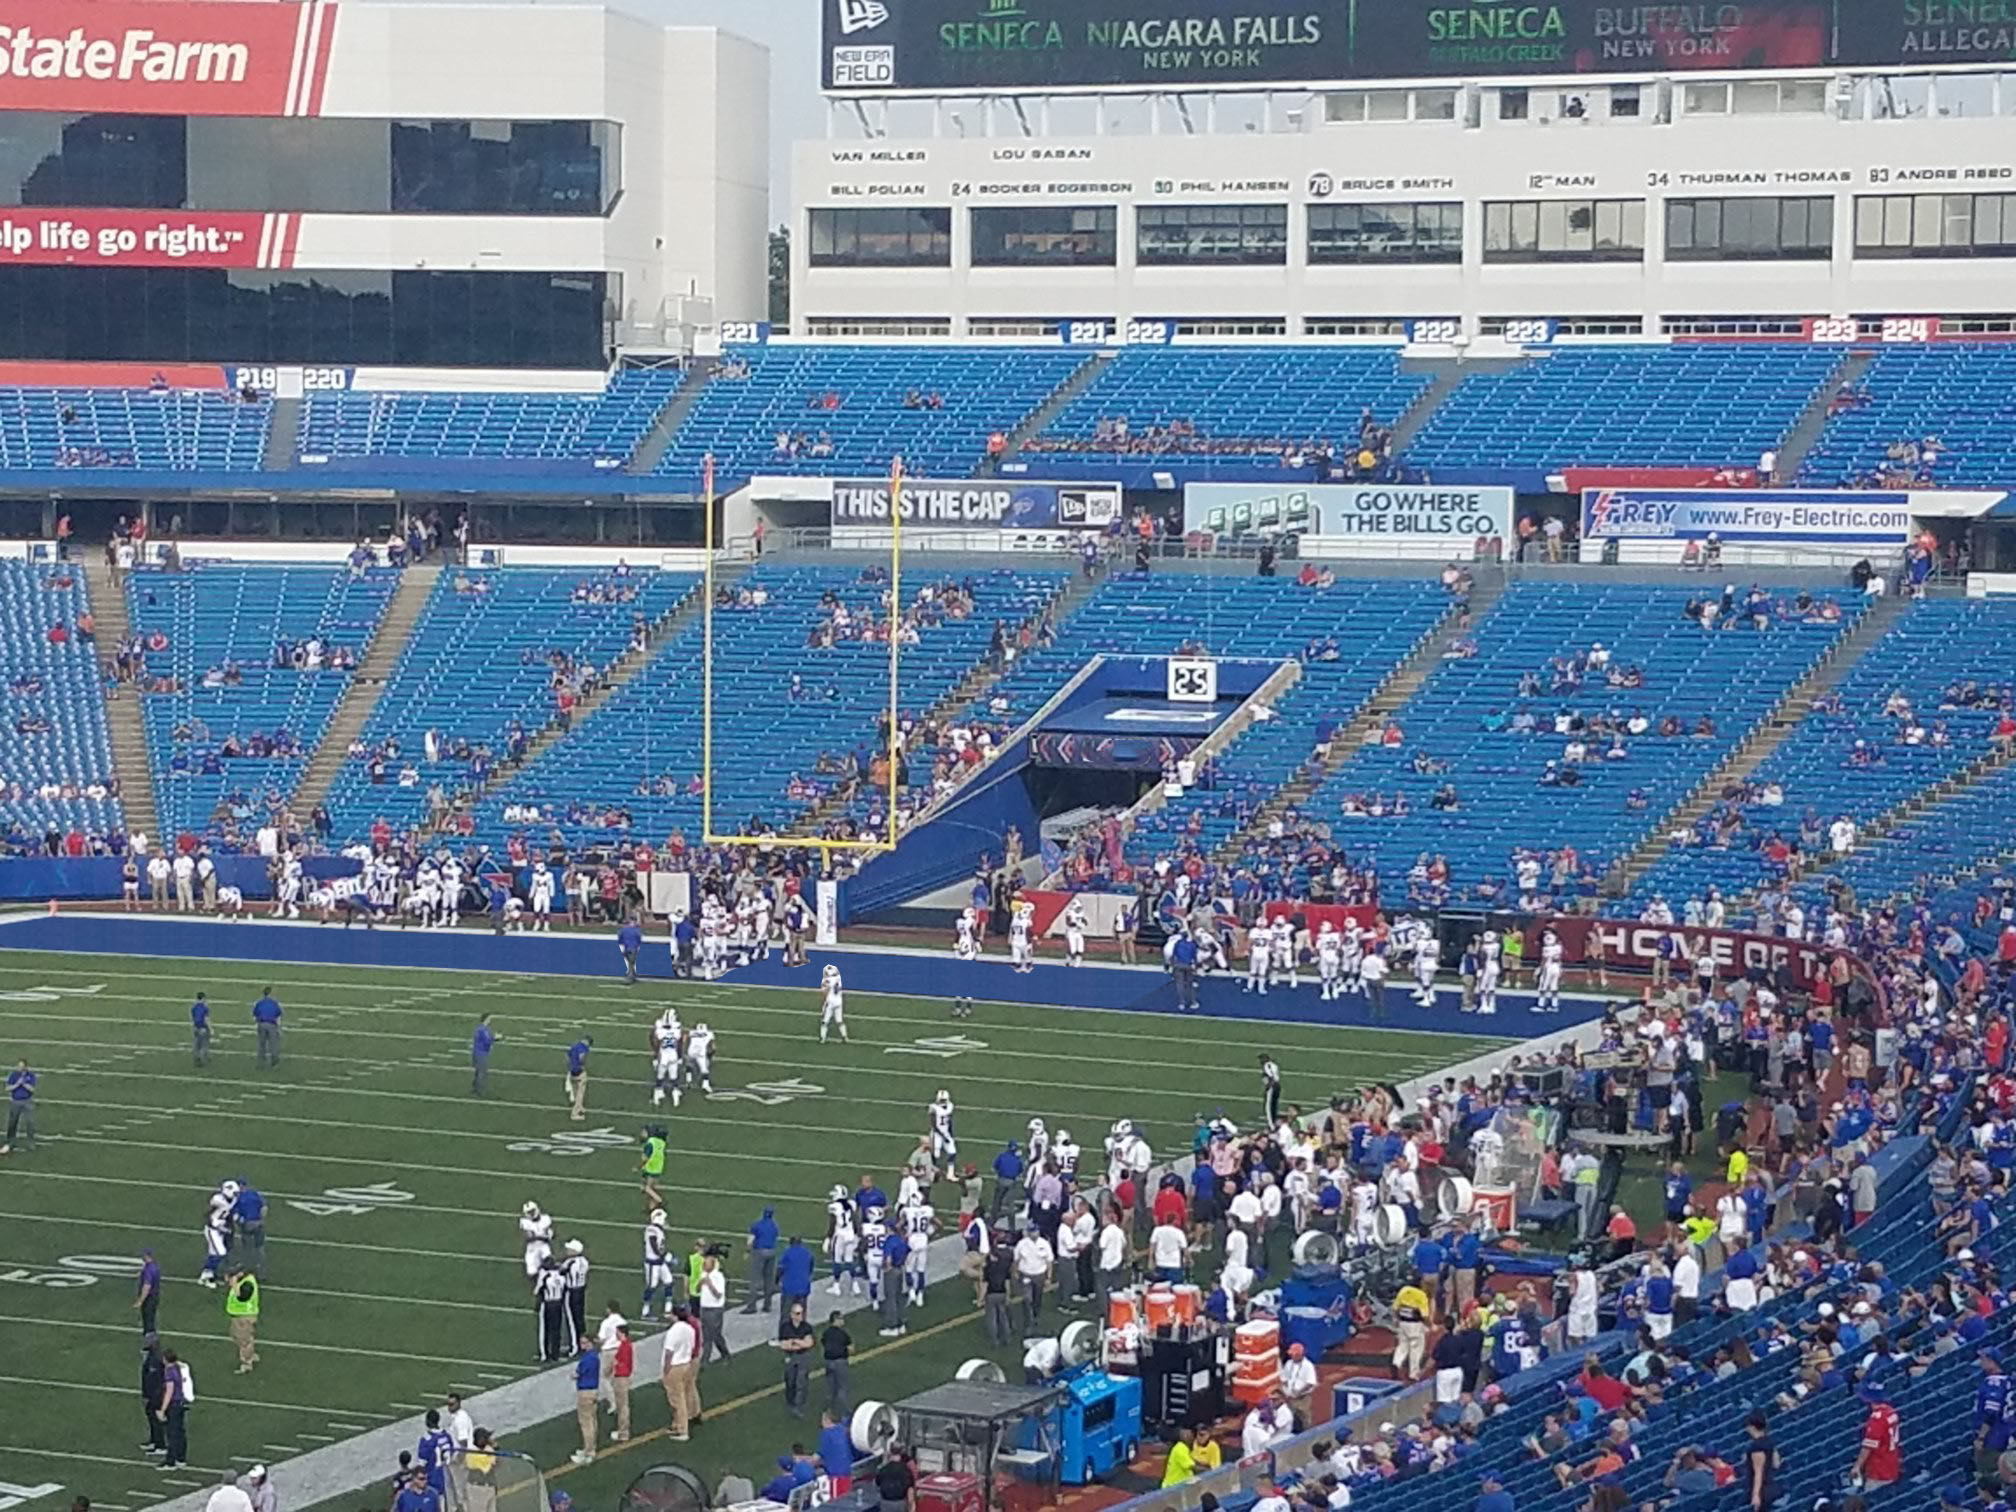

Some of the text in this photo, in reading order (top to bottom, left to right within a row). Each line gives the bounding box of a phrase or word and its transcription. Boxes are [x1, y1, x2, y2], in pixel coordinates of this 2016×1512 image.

[1086, 15, 1321, 48] NIAGARA FALLS
[1428, 7, 1566, 41] SENECA
[1594, 5, 1743, 37] BUFFALO
[939, 20, 1064, 51] SENECA
[1902, 28, 2016, 52] ALLEGA
[835, 49, 890, 62] NEW ERA
[1602, 37, 1731, 59] NEW YORK
[1143, 49, 1262, 70] NEW YORK
[835, 65, 891, 82] FIELD
[832, 151, 926, 162] VAN MILLER
[993, 149, 1092, 160] LOU SABAN
[1341, 178, 1453, 191] BRUCE SMITH
[1554, 176, 1596, 187] MAN
[1647, 171, 1851, 187] 34 THURMAN THOMAS
[1896, 169, 1957, 180] ANDRE
[831, 185, 926, 195] BILL POLIAN
[951, 183, 971, 196] 24
[979, 184, 1042, 194] BOOKER
[1180, 181, 1216, 192] PHIL
[1221, 180, 1290, 192] HANSEN
[40, 220, 91, 250] life
[98, 228, 137, 257] go
[722, 322, 760, 344] 221
[1070, 321, 1106, 344] 221
[1127, 321, 1167, 344] 222
[1413, 320, 1456, 343] 222
[1505, 320, 1549, 343] 223
[1812, 319, 1857, 342] 223
[1881, 318, 1928, 342] 224
[236, 368, 276, 390] 219
[303, 368, 346, 390] 220
[834, 488, 888, 518] THIS
[914, 488, 961, 520] THE
[961, 490, 1011, 521] CAP
[1354, 492, 1480, 513] GO WHERE
[1606, 496, 1677, 524] FREY
[1343, 513, 1499, 535] THE BILLS GO.
[1689, 506, 1909, 529] www.Frey-Electric.com
[704, 1083, 826, 1105] 20
[505, 1131, 636, 1156] 30
[286, 1187, 416, 1216] 40
